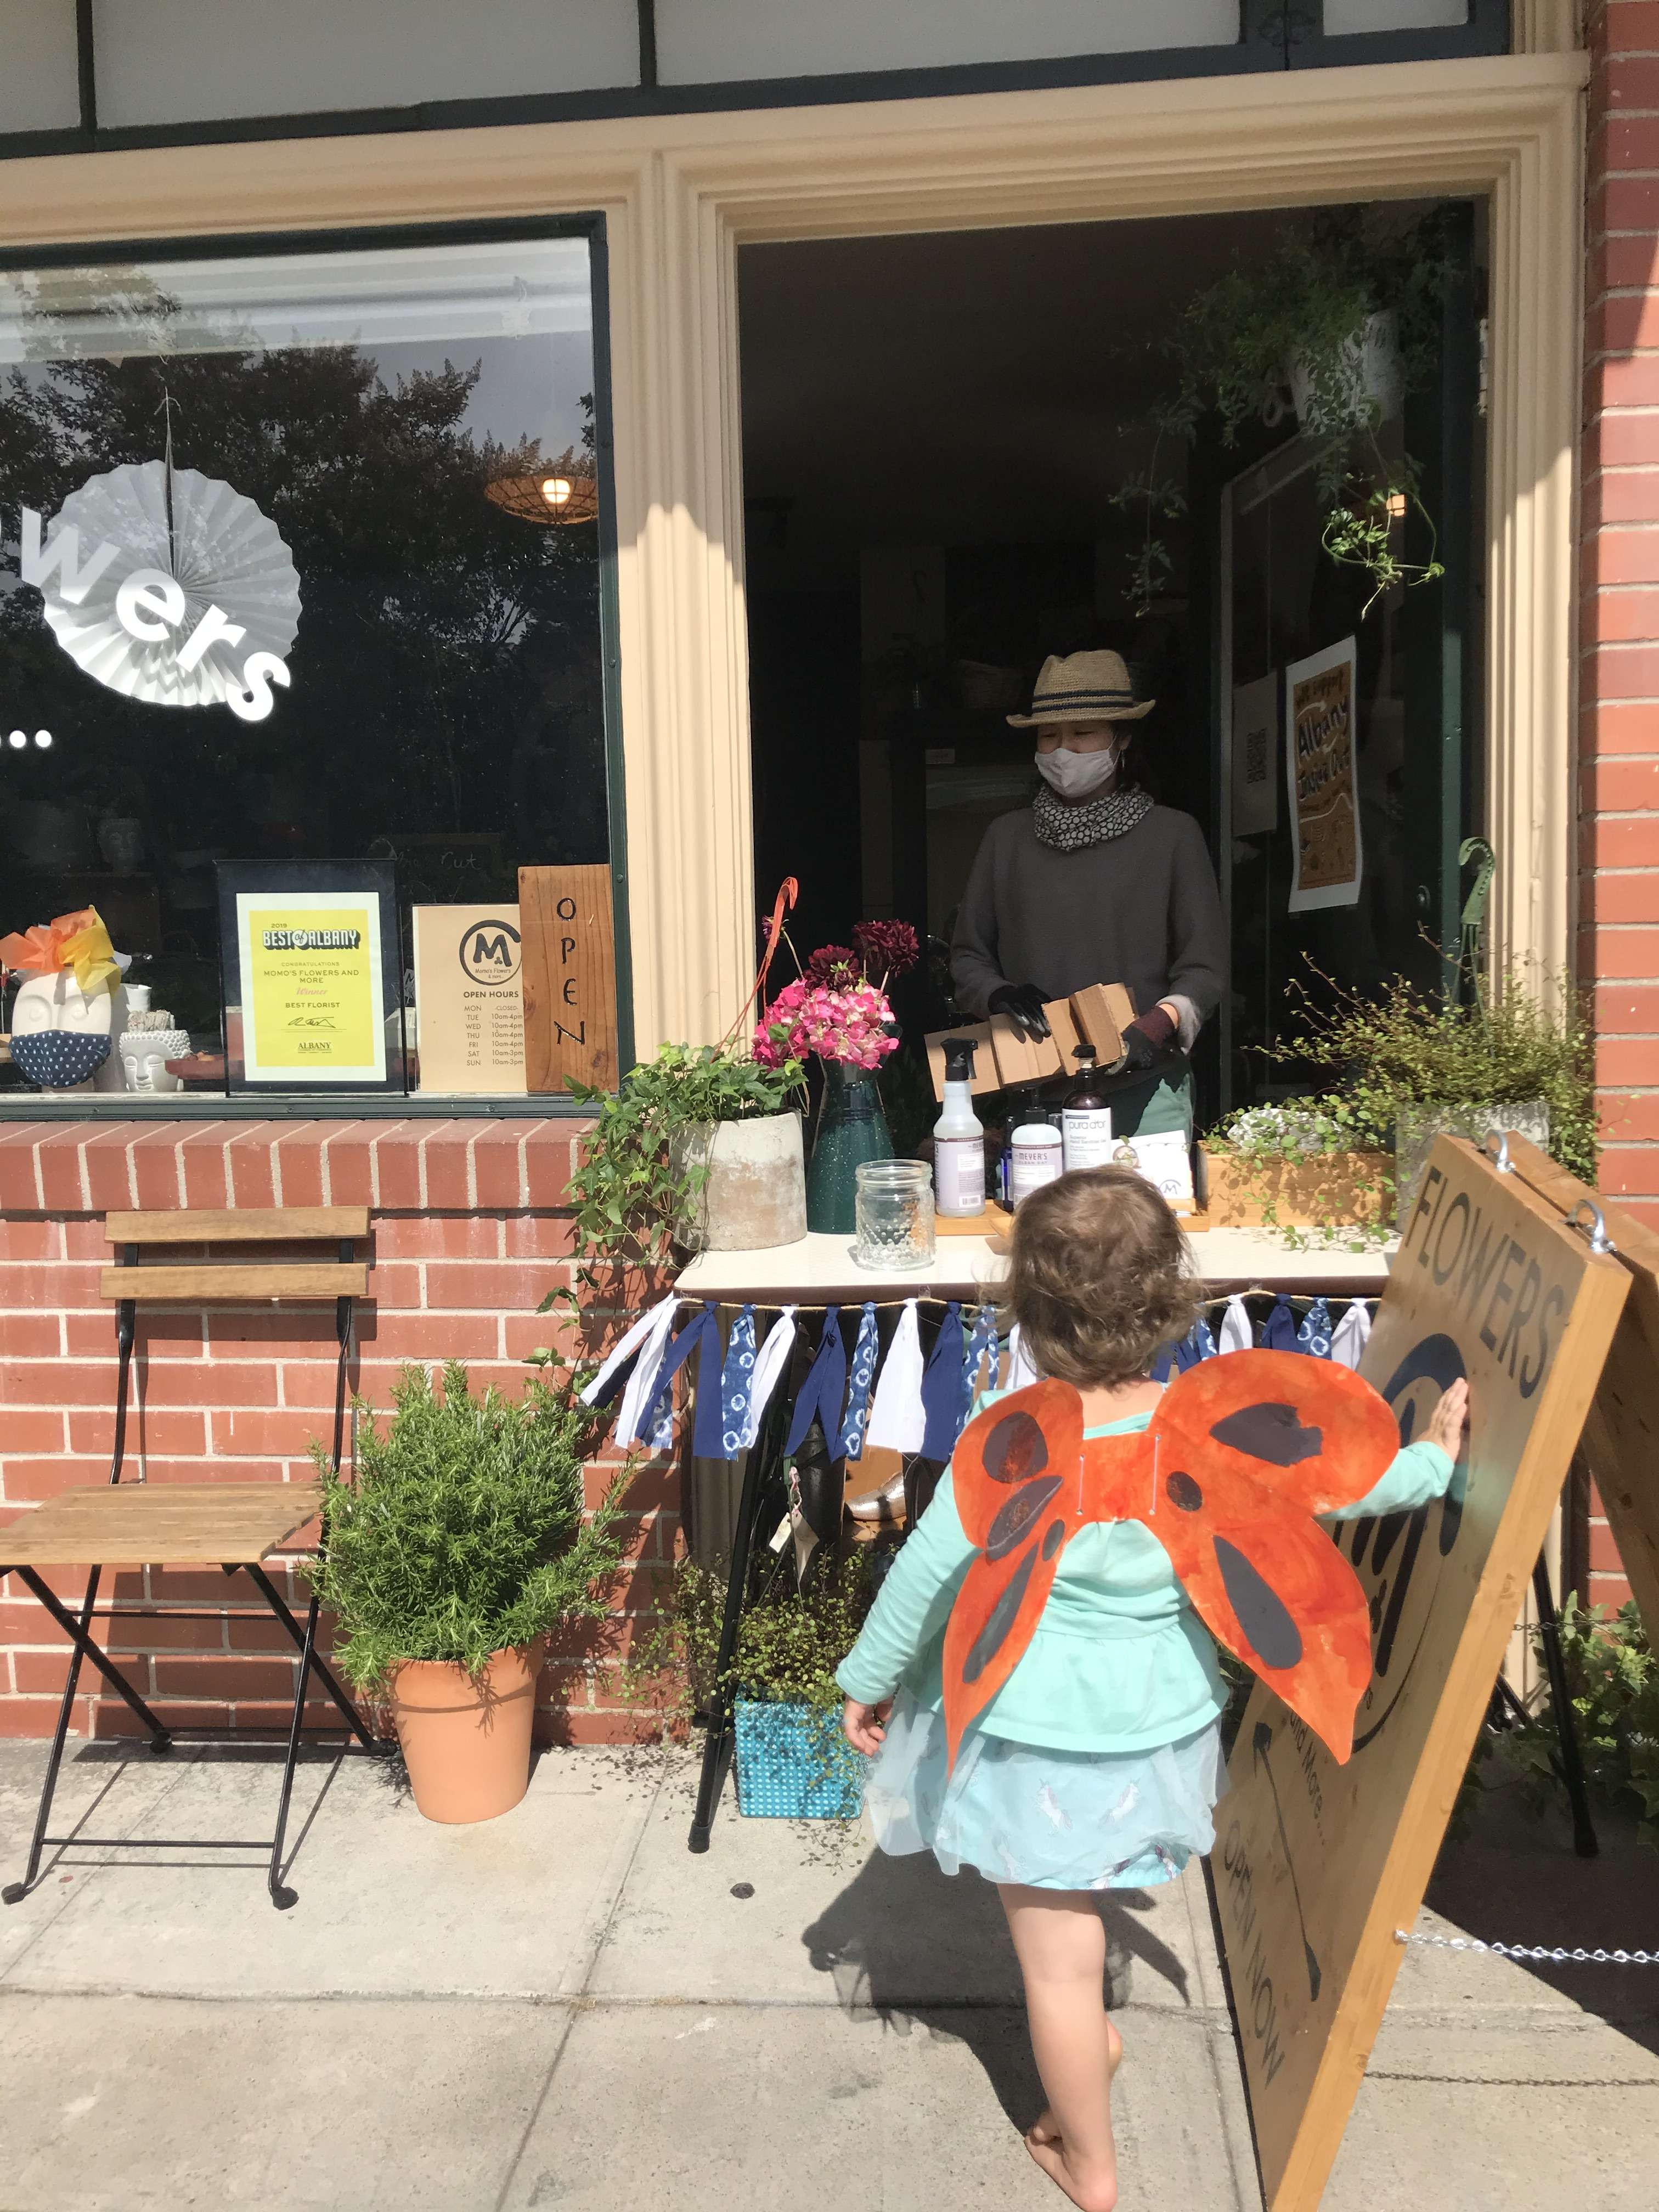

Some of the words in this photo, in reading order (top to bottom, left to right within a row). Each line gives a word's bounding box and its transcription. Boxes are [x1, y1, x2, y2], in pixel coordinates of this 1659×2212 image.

[0, 506, 290, 721] wers
[263, 930, 294, 947] BEST
[308, 929, 359, 947] ALBANY
[473, 933, 512, 967] M
[554, 898, 585, 1045] OPEN
[1069, 1121, 1088, 1131] pura
[1405, 1166, 1565, 1399] FLOWERS
[1224, 1820, 1257, 1951] OPEN
[1246, 1932, 1285, 2090] NOW
